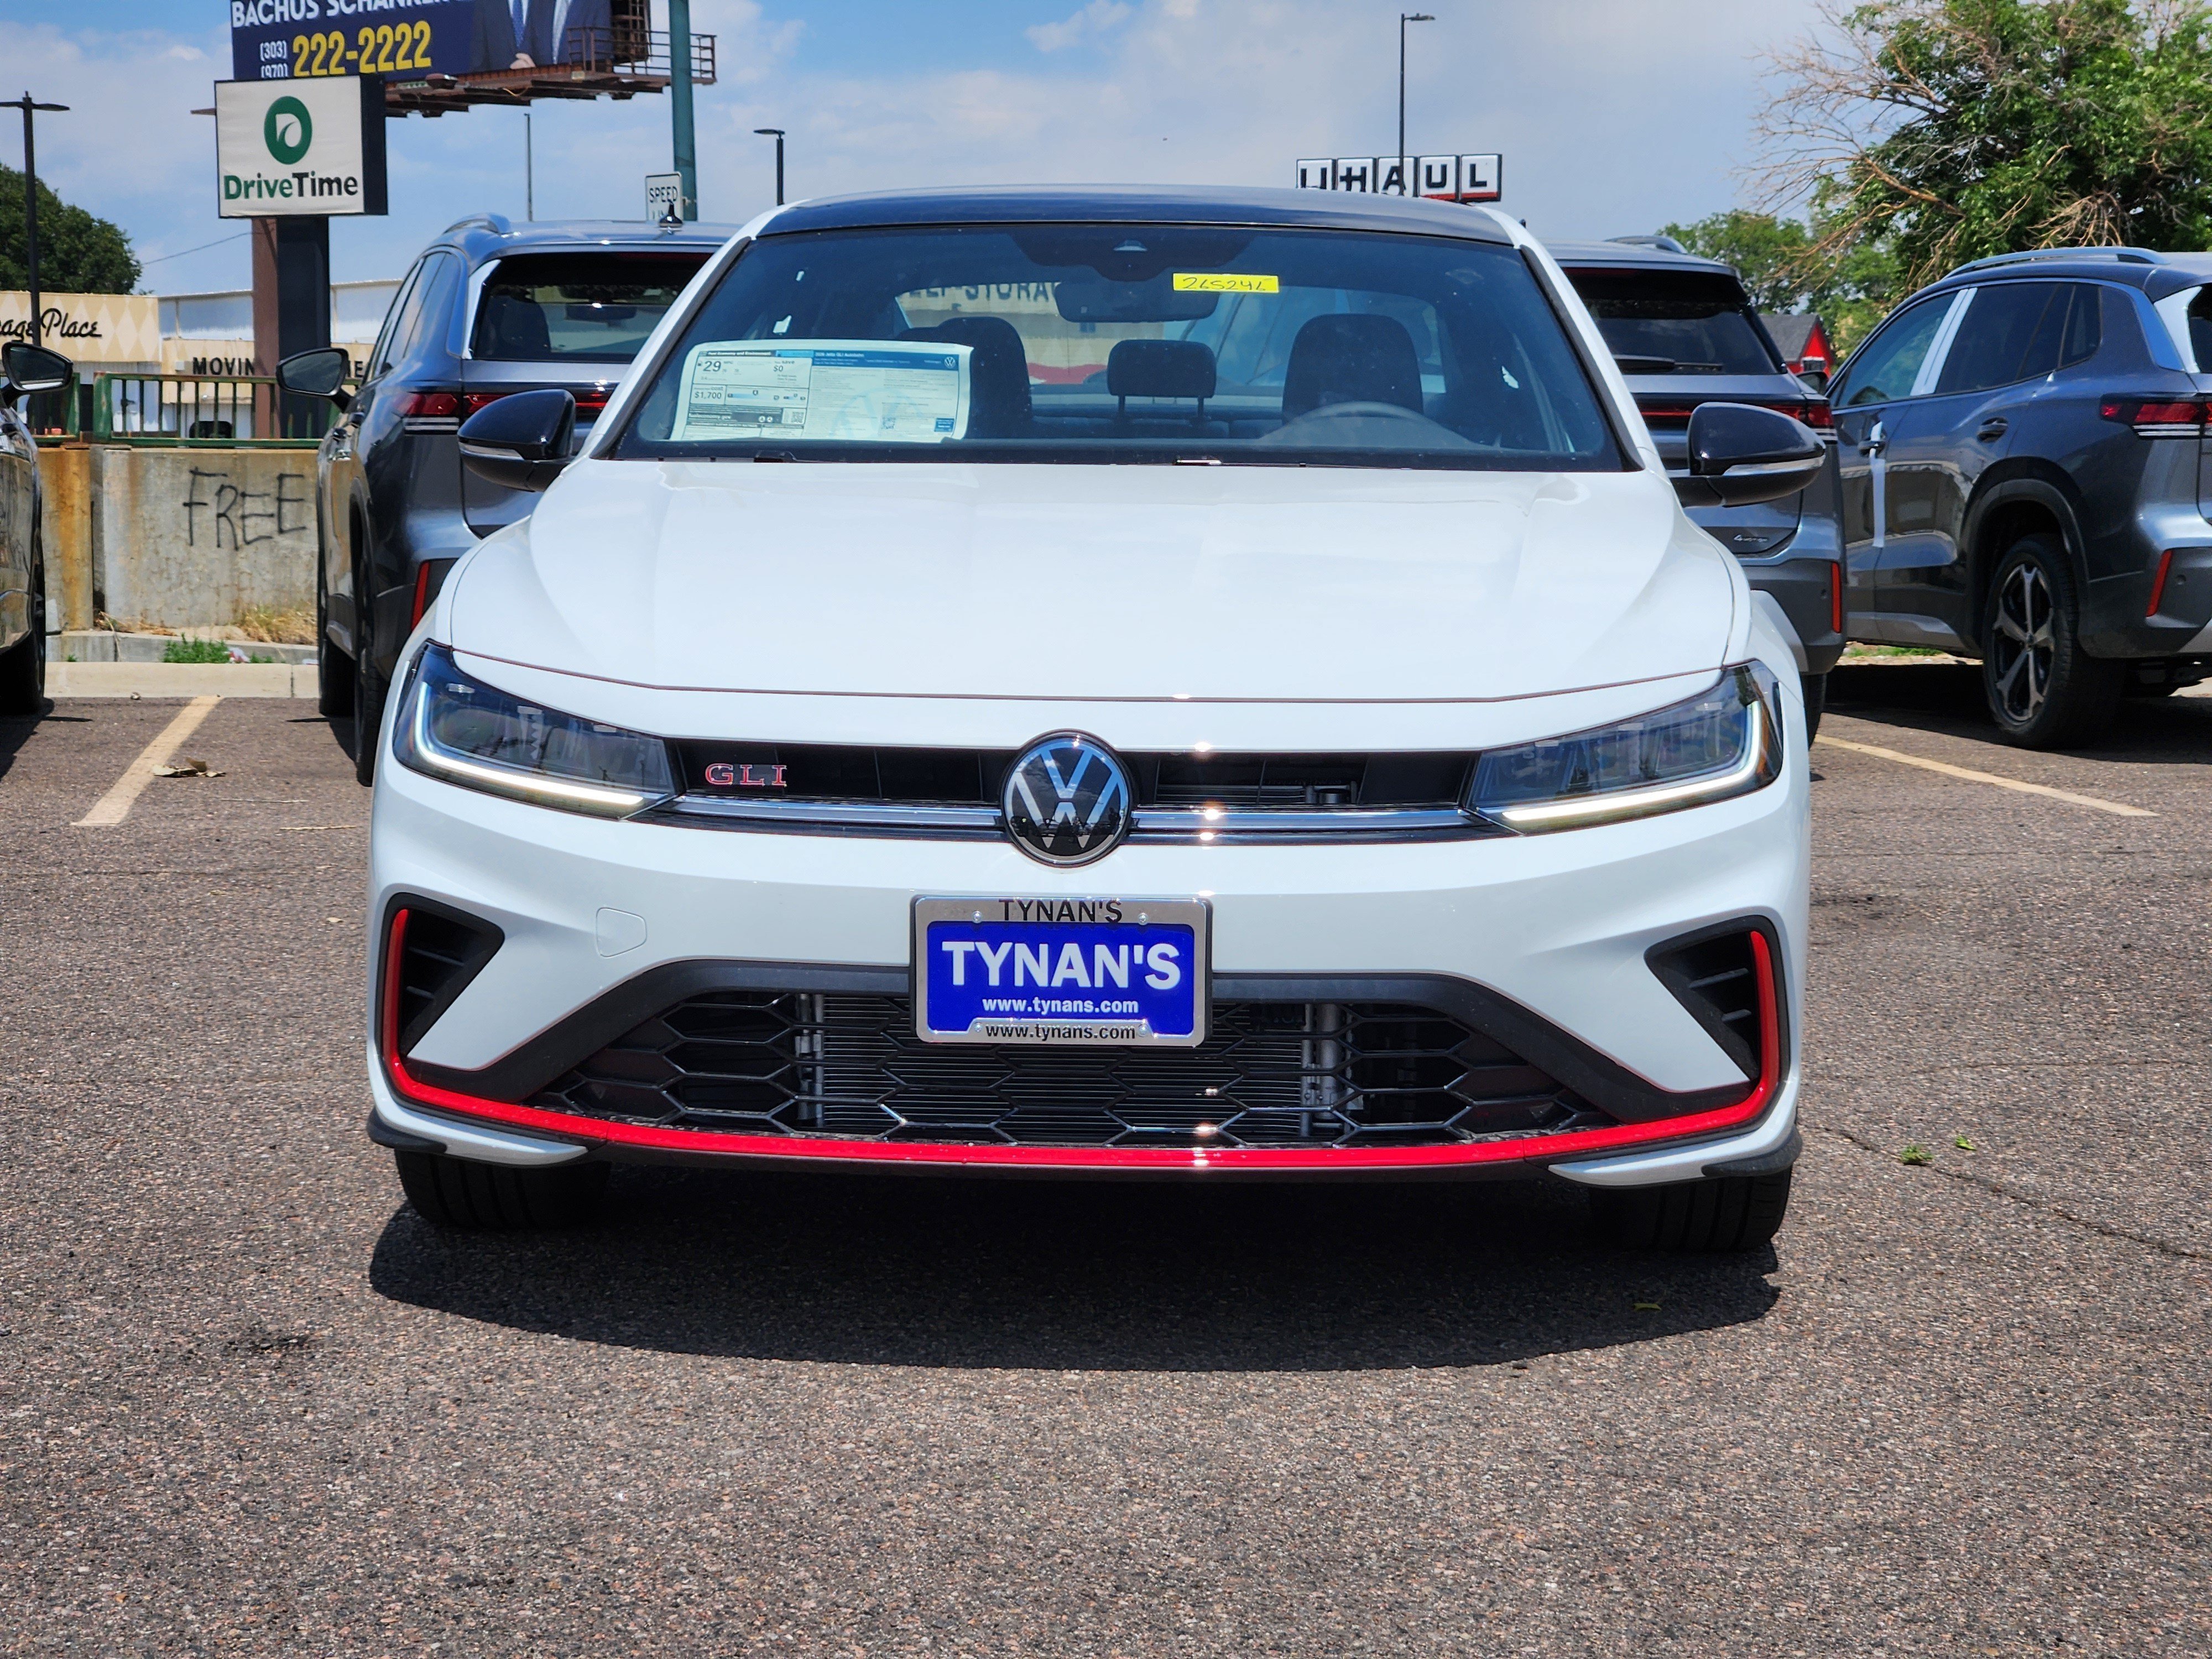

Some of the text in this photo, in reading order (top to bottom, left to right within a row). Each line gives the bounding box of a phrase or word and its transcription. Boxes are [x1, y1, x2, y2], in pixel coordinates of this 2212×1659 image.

[232, 0, 319, 27] BACHUS
[260, 40, 287, 61] (303)
[293, 20, 431, 77] 222-2222
[223, 170, 358, 200] DriveTime
[649, 186, 678, 202] SPEED
[40, 307, 102, 338] Place
[703, 361, 721, 372] 29
[183, 466, 307, 551] FREE
[705, 763, 787, 786] GLI
[999, 899, 1123, 922] TYNAN'S
[942, 941, 1181, 990] TYNAN'S
[982, 997, 1139, 1014] www.tynans.com
[985, 1023, 1136, 1040] www.tynans.com
